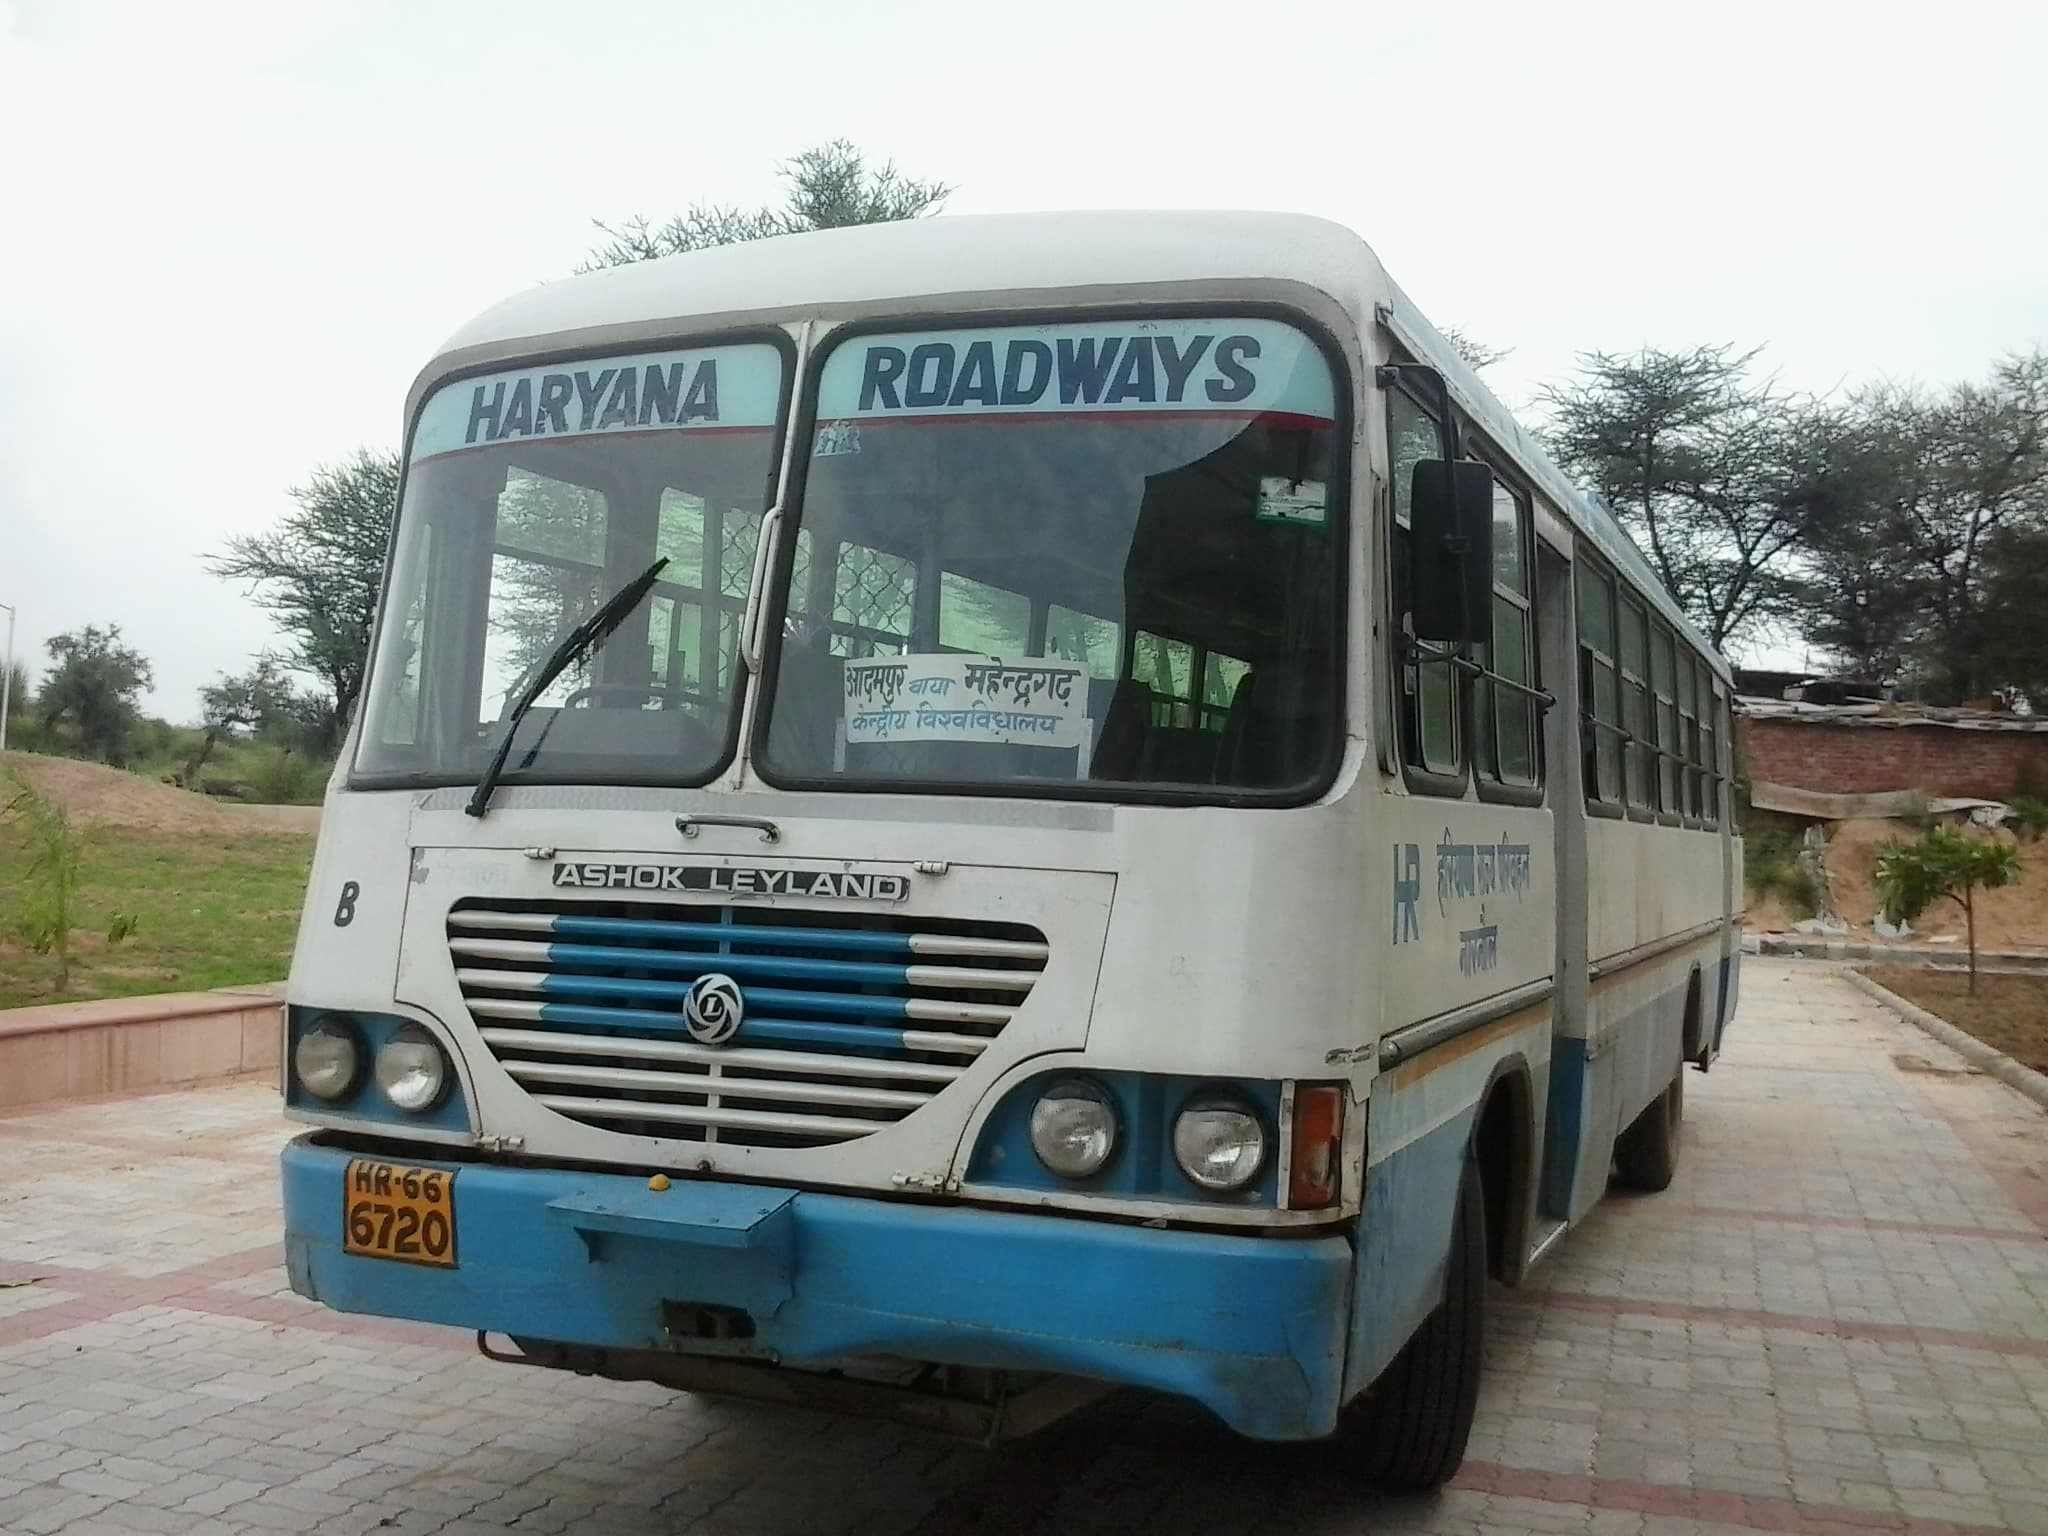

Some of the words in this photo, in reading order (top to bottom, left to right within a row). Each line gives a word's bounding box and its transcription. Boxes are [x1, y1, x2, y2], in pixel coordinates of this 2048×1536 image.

[465, 359, 719, 443] HARYANA
[858, 335, 1260, 411] ROADWAYS
[846, 664, 908, 704] आदमपुर
[908, 677, 956, 696] वाया
[334, 880, 361, 928] B
[555, 864, 684, 890] ASHOK
[709, 869, 909, 901] LEYLAND
[1392, 843, 1421, 945] HR
[355, 1161, 443, 1204] HR-66
[350, 1201, 449, 1257] 6720
